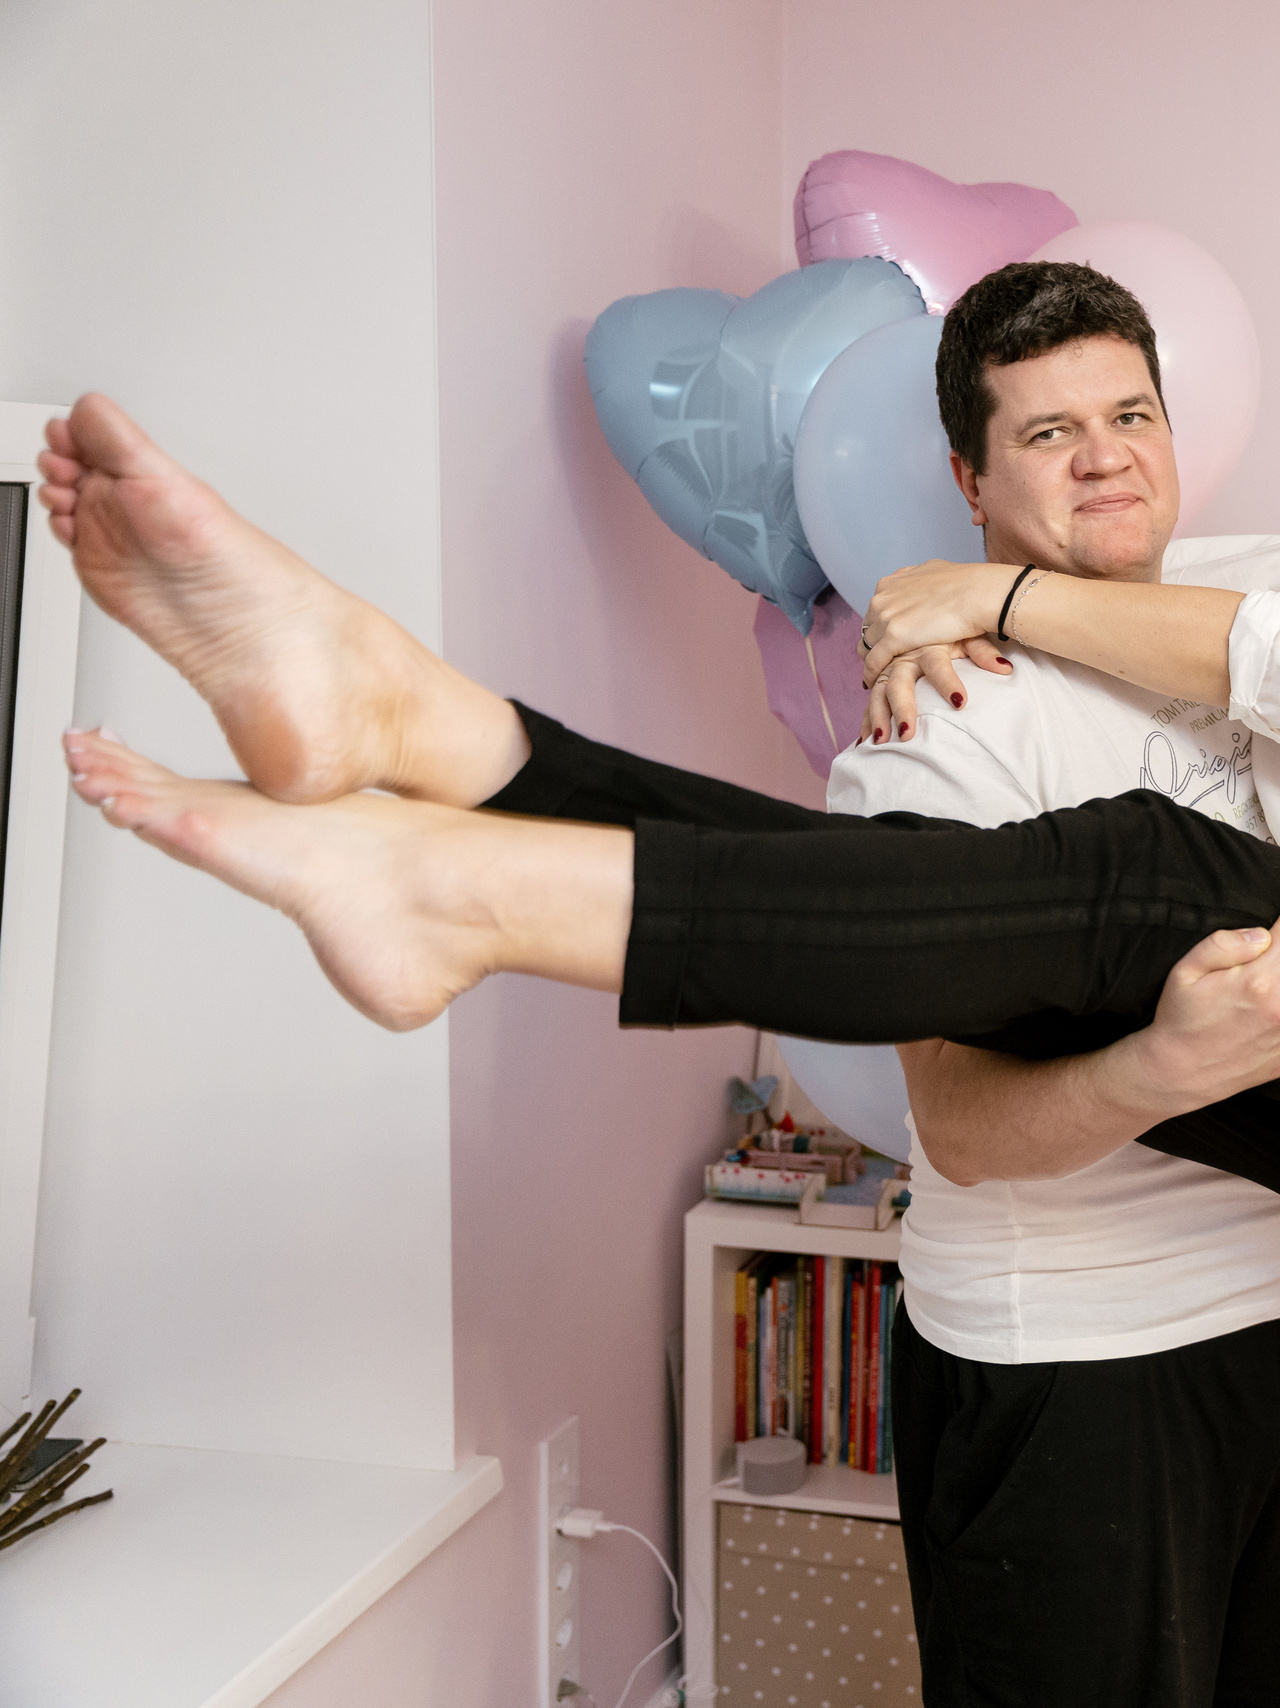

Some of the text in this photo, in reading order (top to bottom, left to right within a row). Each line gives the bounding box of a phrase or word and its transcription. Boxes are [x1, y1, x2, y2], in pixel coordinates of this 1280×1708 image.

[1151, 698, 1201, 728] TOM TAIL
[1140, 731, 1252, 804] Origi
